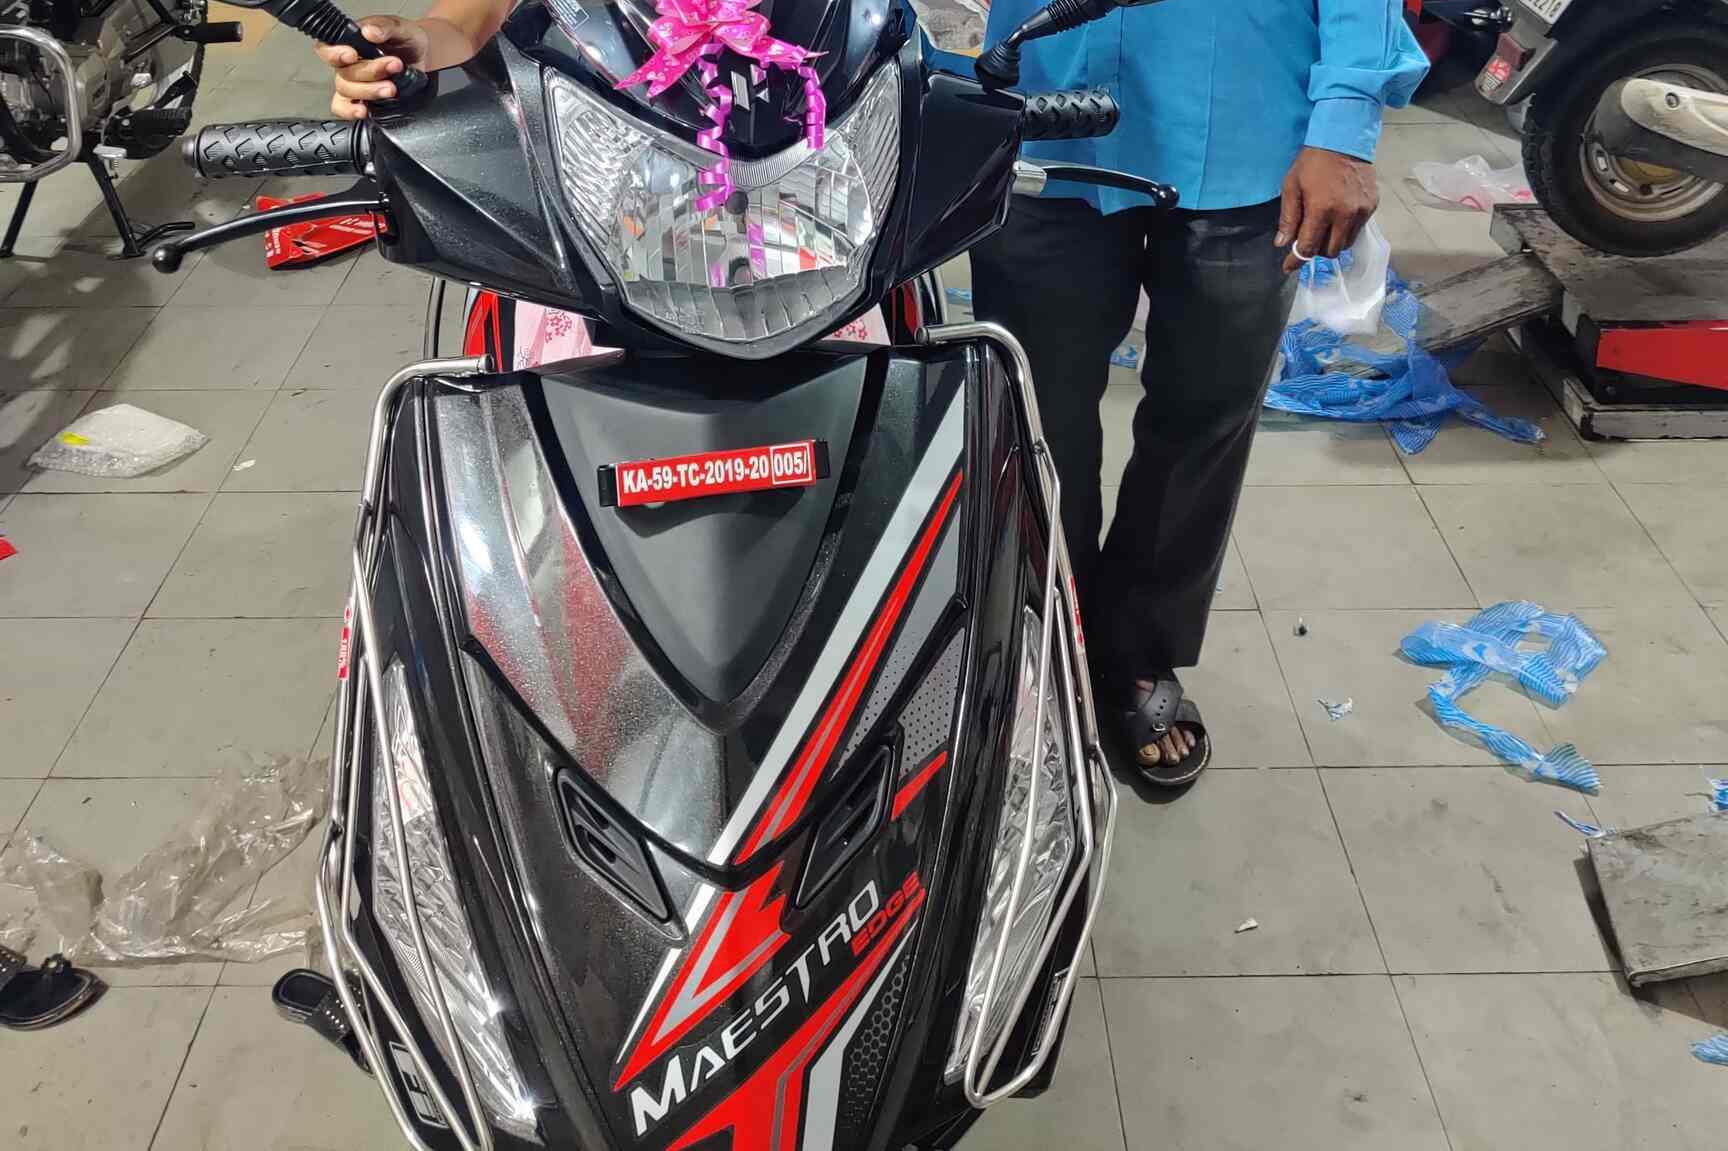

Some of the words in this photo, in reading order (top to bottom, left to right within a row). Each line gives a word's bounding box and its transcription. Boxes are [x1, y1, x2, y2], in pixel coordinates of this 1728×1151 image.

[622, 454, 770, 494] KA-59-TC-2019-20
[850, 870, 921, 957] EDGE
[630, 879, 880, 1137] MAESTRO
